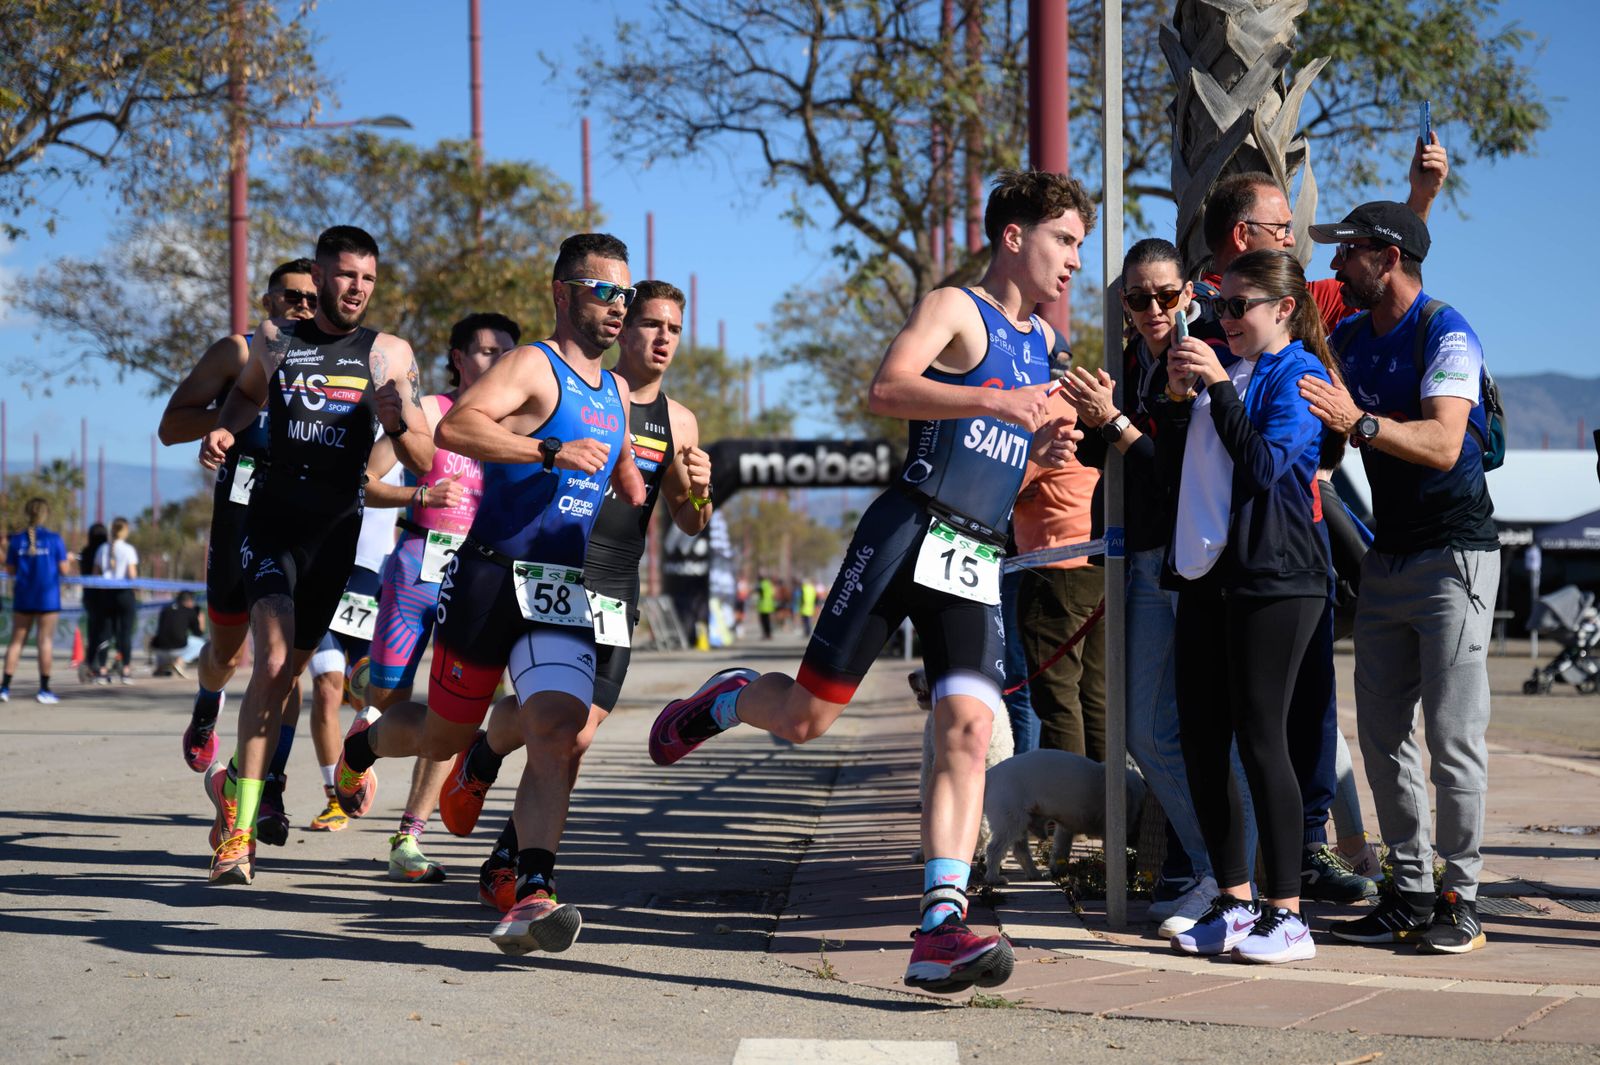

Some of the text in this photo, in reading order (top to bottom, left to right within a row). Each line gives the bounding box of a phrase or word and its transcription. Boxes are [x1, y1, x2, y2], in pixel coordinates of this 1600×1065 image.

[990, 332, 1016, 356] SPIRAL
[286, 347, 319, 358] Unlimited
[285, 354, 325, 366] experiences
[331, 391, 356, 400] ACTIVE
[328, 403, 351, 412] SPORT
[287, 420, 346, 449] MUÑOZ
[590, 426, 609, 437] SPORT
[644, 421, 666, 435] GOBIK
[963, 419, 1029, 470] SANTI
[640, 449, 660, 460] ACTIVE
[635, 460, 656, 470] SPORT
[567, 477, 600, 491] syngenta
[573, 499, 594, 509] grupo
[940, 548, 979, 588] 15
[831, 545, 875, 617] syngenta
[534, 583, 571, 615] 58
[340, 605, 371, 628] 47
